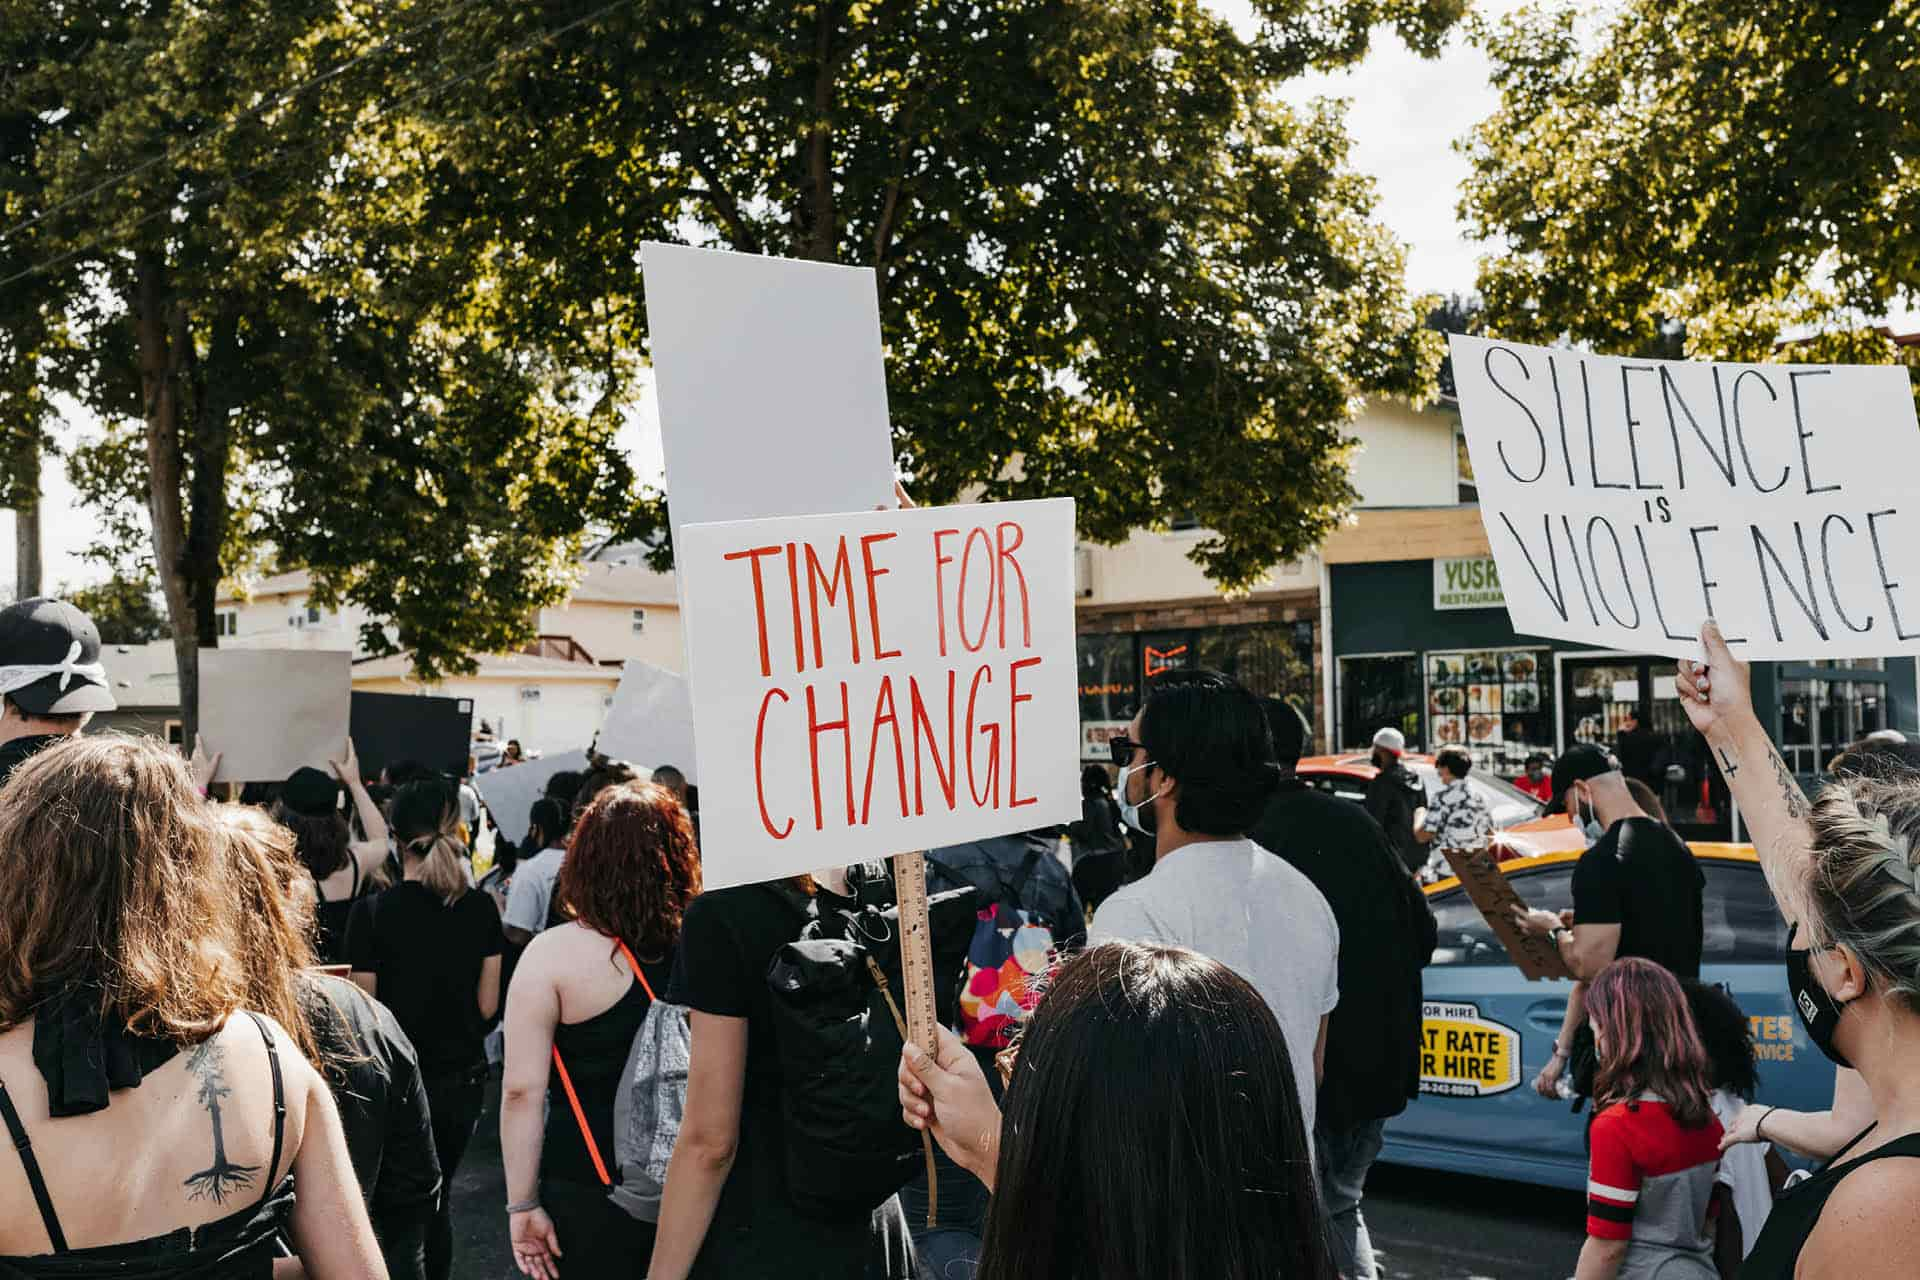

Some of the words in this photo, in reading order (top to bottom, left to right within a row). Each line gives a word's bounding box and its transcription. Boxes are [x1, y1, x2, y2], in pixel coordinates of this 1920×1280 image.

[1484, 345, 1842, 496] SILENCE
[1643, 495, 1672, 524] IS
[724, 531, 904, 678] TIME
[932, 521, 1031, 657] FOR
[1495, 508, 1920, 643] VIOLENCE
[753, 656, 1042, 841] CHANGE
[1444, 1007, 1474, 1018] HIRE
[1446, 1030, 1500, 1055] RATE
[1443, 1055, 1497, 1081] HIRE
